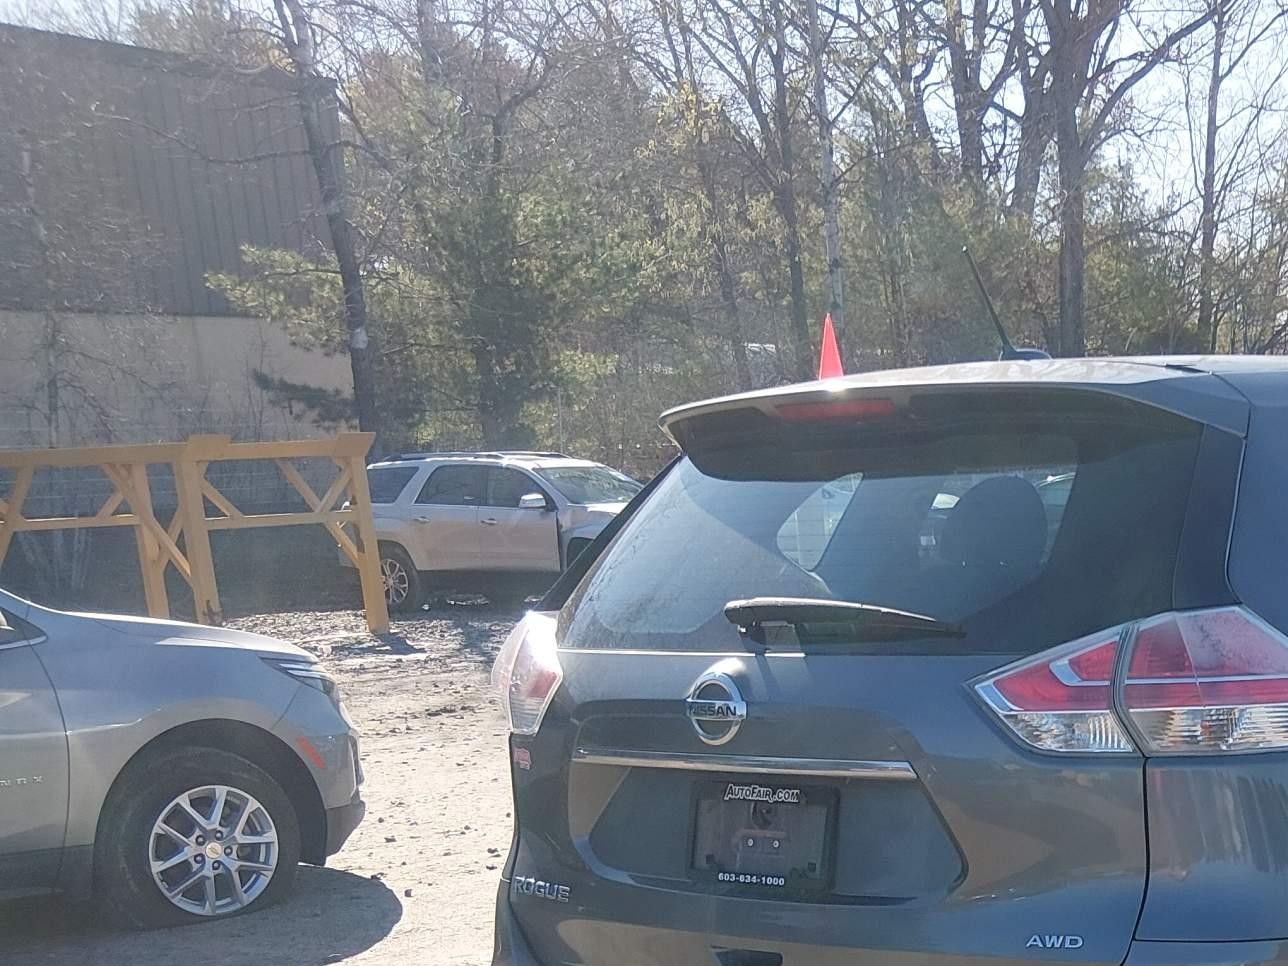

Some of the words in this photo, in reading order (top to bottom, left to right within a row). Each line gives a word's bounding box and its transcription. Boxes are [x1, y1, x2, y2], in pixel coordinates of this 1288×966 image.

[688, 703, 737, 717] NISSAN
[513, 875, 571, 903] ROGUE
[1025, 934, 1084, 949] AWD
